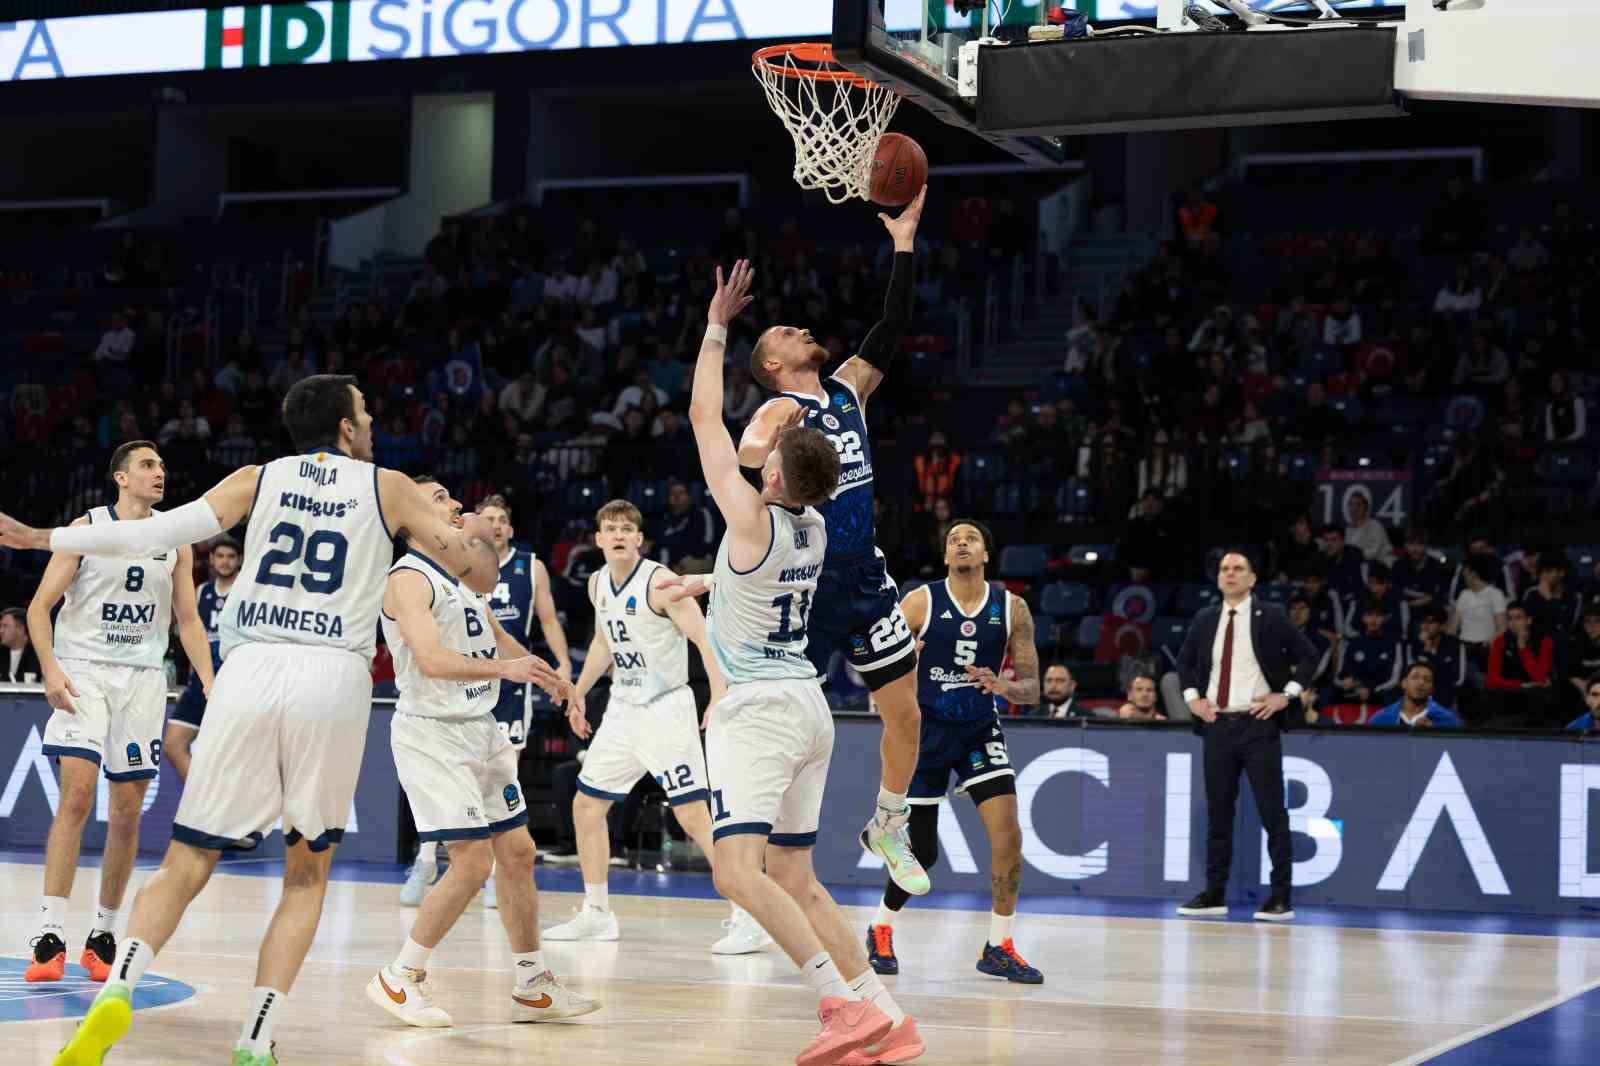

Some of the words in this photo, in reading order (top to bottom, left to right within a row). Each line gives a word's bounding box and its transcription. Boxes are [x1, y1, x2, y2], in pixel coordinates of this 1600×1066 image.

[204, 0, 349, 69] HDI
[1318, 484, 1406, 526] 104
[255, 521, 348, 594] 29
[125, 566, 144, 592] 8
[102, 603, 156, 623] BAXI
[237, 600, 343, 638] MANRESA
[464, 608, 483, 637] 6
[607, 620, 631, 643] 12
[868, 607, 912, 652] 22
[954, 640, 978, 666] 5
[150, 739, 161, 766] 8
[985, 741, 1009, 765] 5
[664, 764, 695, 791] 12
